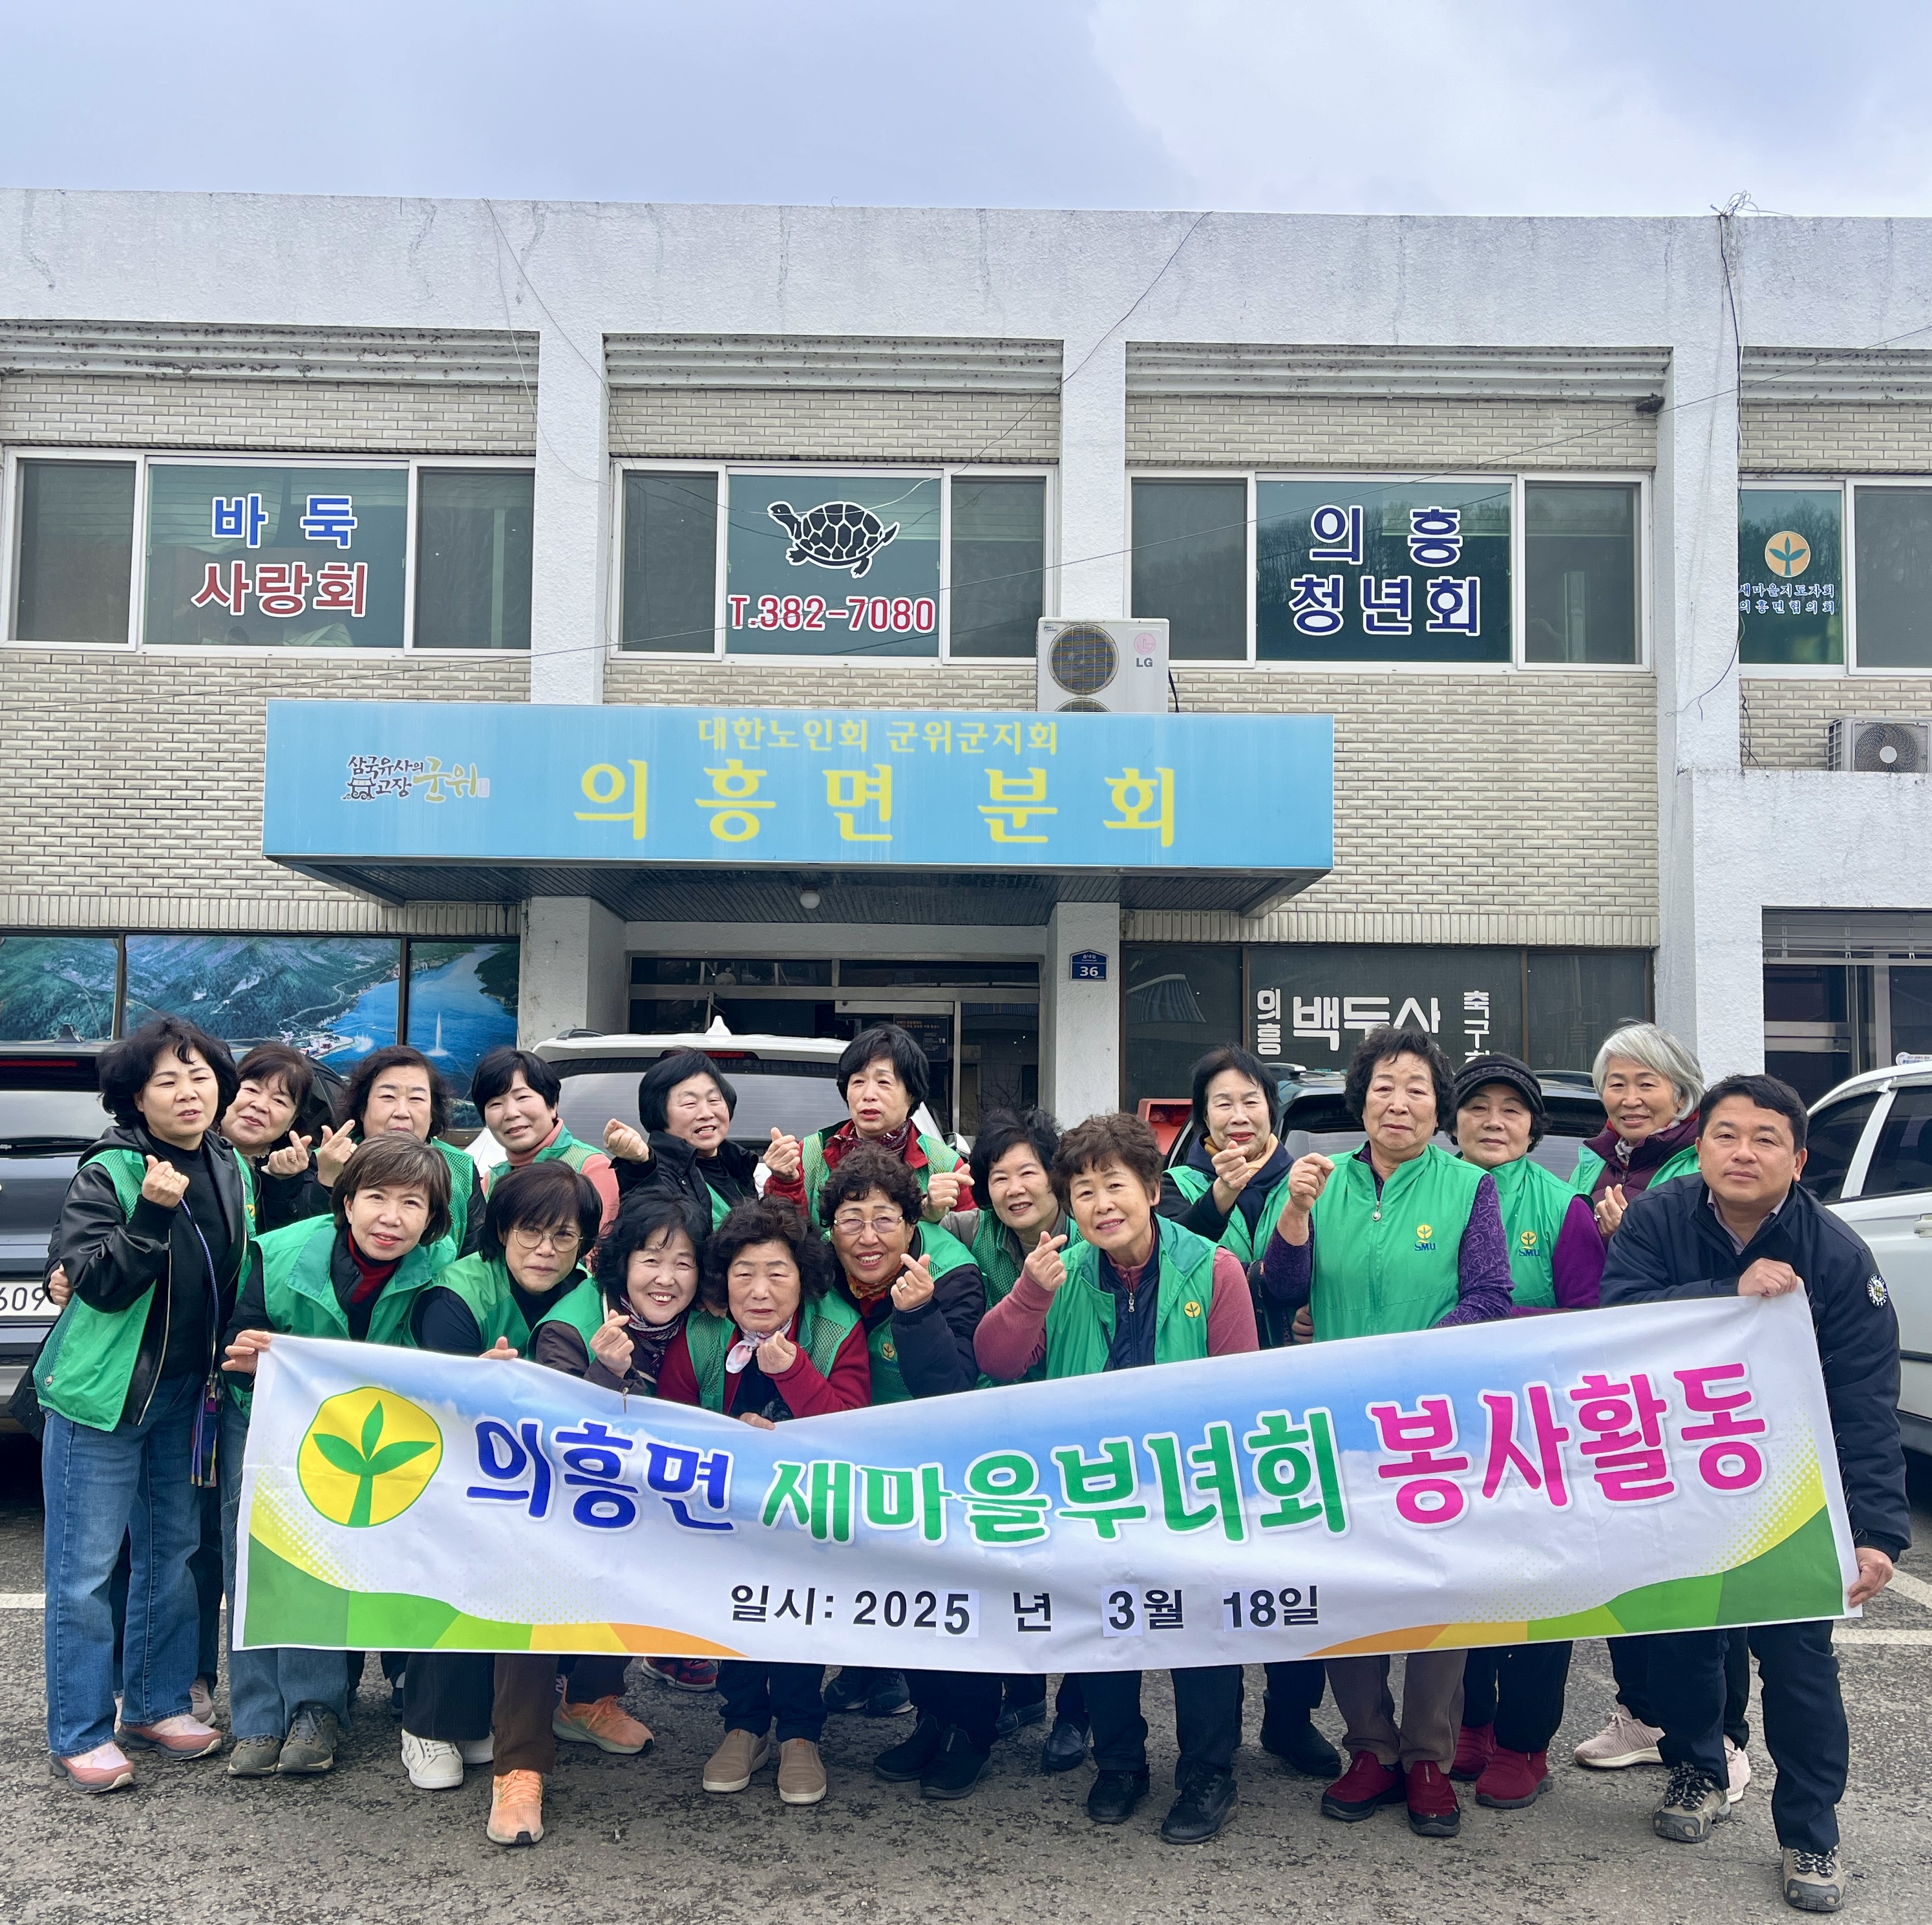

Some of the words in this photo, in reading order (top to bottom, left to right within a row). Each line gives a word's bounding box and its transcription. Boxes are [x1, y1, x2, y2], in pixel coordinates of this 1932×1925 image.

[191, 560, 368, 617] 사랑회
[1288, 573, 1481, 637] 청년회
[1738, 582, 1835, 598] 새마을지도자회
[728, 594, 937, 633] T.382-7080
[1136, 657, 1153, 667] LG
[698, 716, 869, 754] 대한노인회
[886, 719, 1059, 755] 군위군지회
[348, 755, 424, 780] 삼국유사의
[412, 756, 478, 802] 군위
[376, 777, 412, 798] 고장
[1079, 966, 1099, 977] 36
[1257, 988, 1281, 1055] 의흥
[465, 1417, 735, 1533] 의흥면
[759, 1407, 1350, 1546] 새마을부녀회
[1367, 1361, 1768, 1526] 봉사활동
[730, 1584, 834, 1626] 일시:
[853, 1590, 971, 1636] 2025
[1013, 1591, 1052, 1633] 년
[1108, 1589, 1184, 1631] 3월
[1223, 1585, 1320, 1629] 18일
